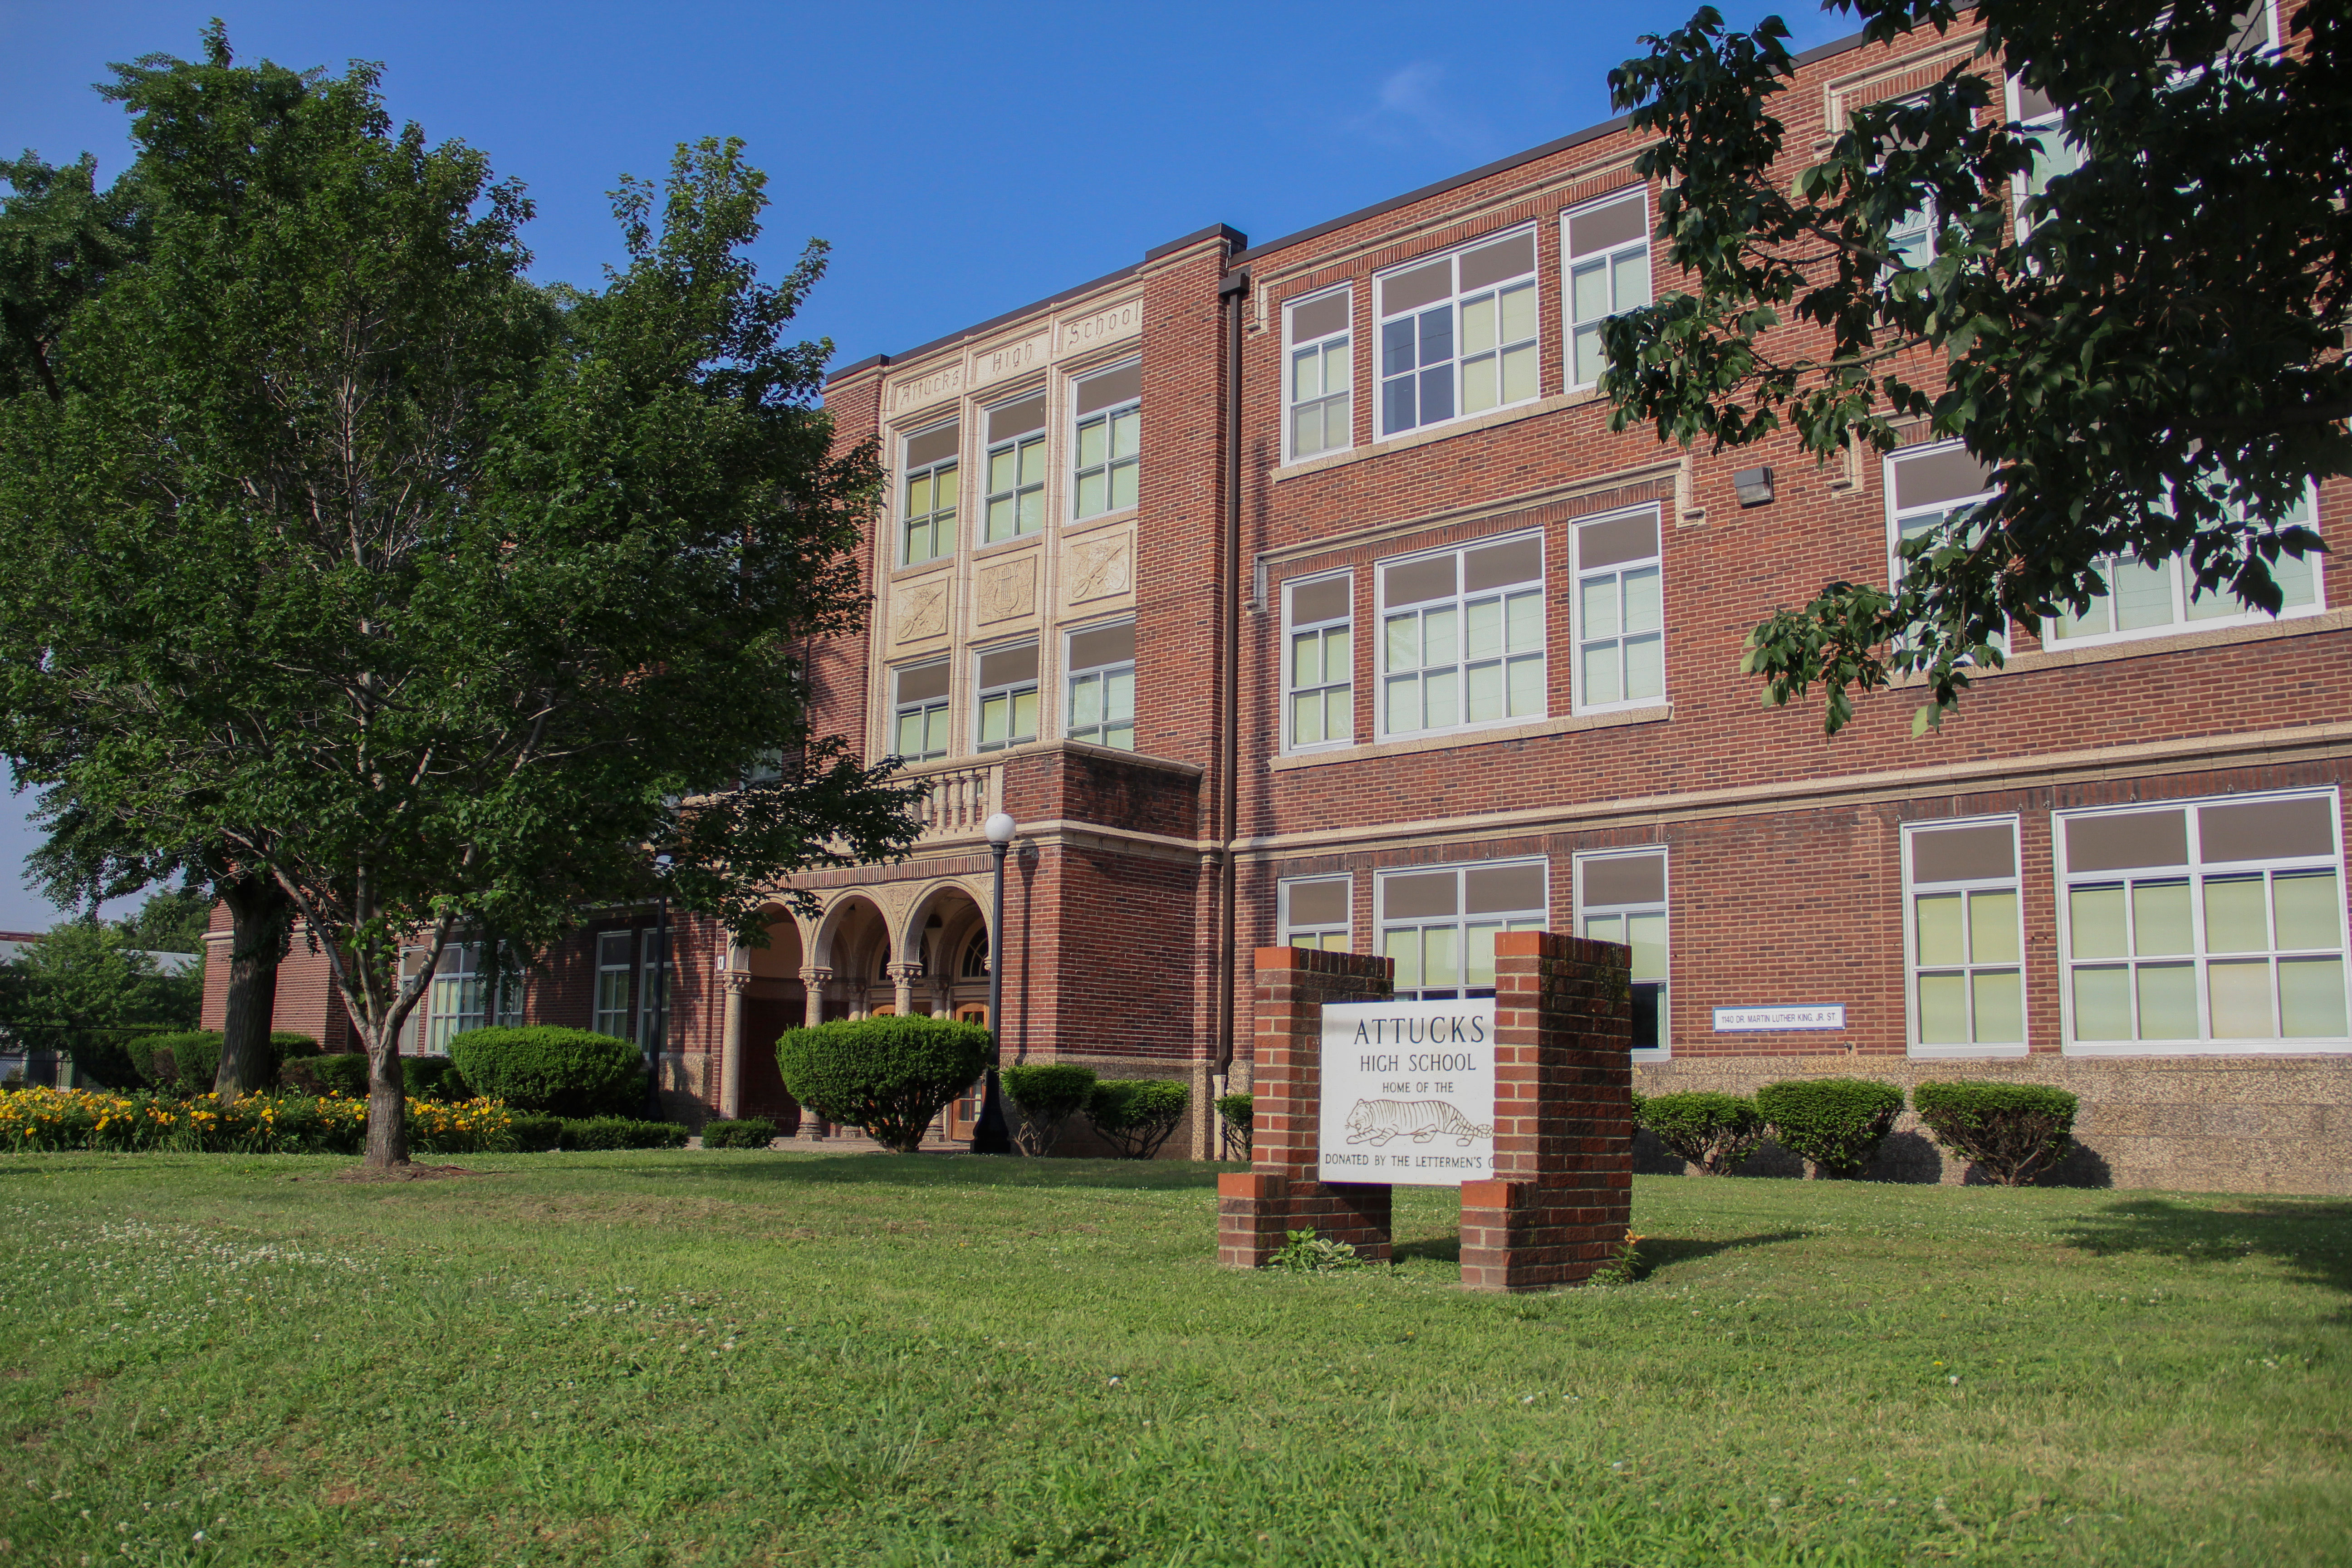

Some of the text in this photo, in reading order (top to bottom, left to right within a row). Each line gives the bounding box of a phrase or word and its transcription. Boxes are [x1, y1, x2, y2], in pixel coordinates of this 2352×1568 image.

[900, 301, 1140, 407] Attucks High School
[1721, 1015, 1734, 1024] 1140
[1747, 1014, 1770, 1023] MARTIN
[1772, 1014, 1795, 1023] LUTHER
[1827, 1012, 1837, 1021] ST.
[1353, 1016, 1485, 1044] ATTUCKS
[1360, 1054, 1476, 1072] HIGH SCHOOL
[1382, 1082, 1454, 1093] HOME OF THE
[1325, 1153, 1368, 1165] DONATED
[1375, 1155, 1386, 1166] BY
[1391, 1156, 1410, 1166] THE
[1416, 1156, 1482, 1168] LETTERMEN'S
